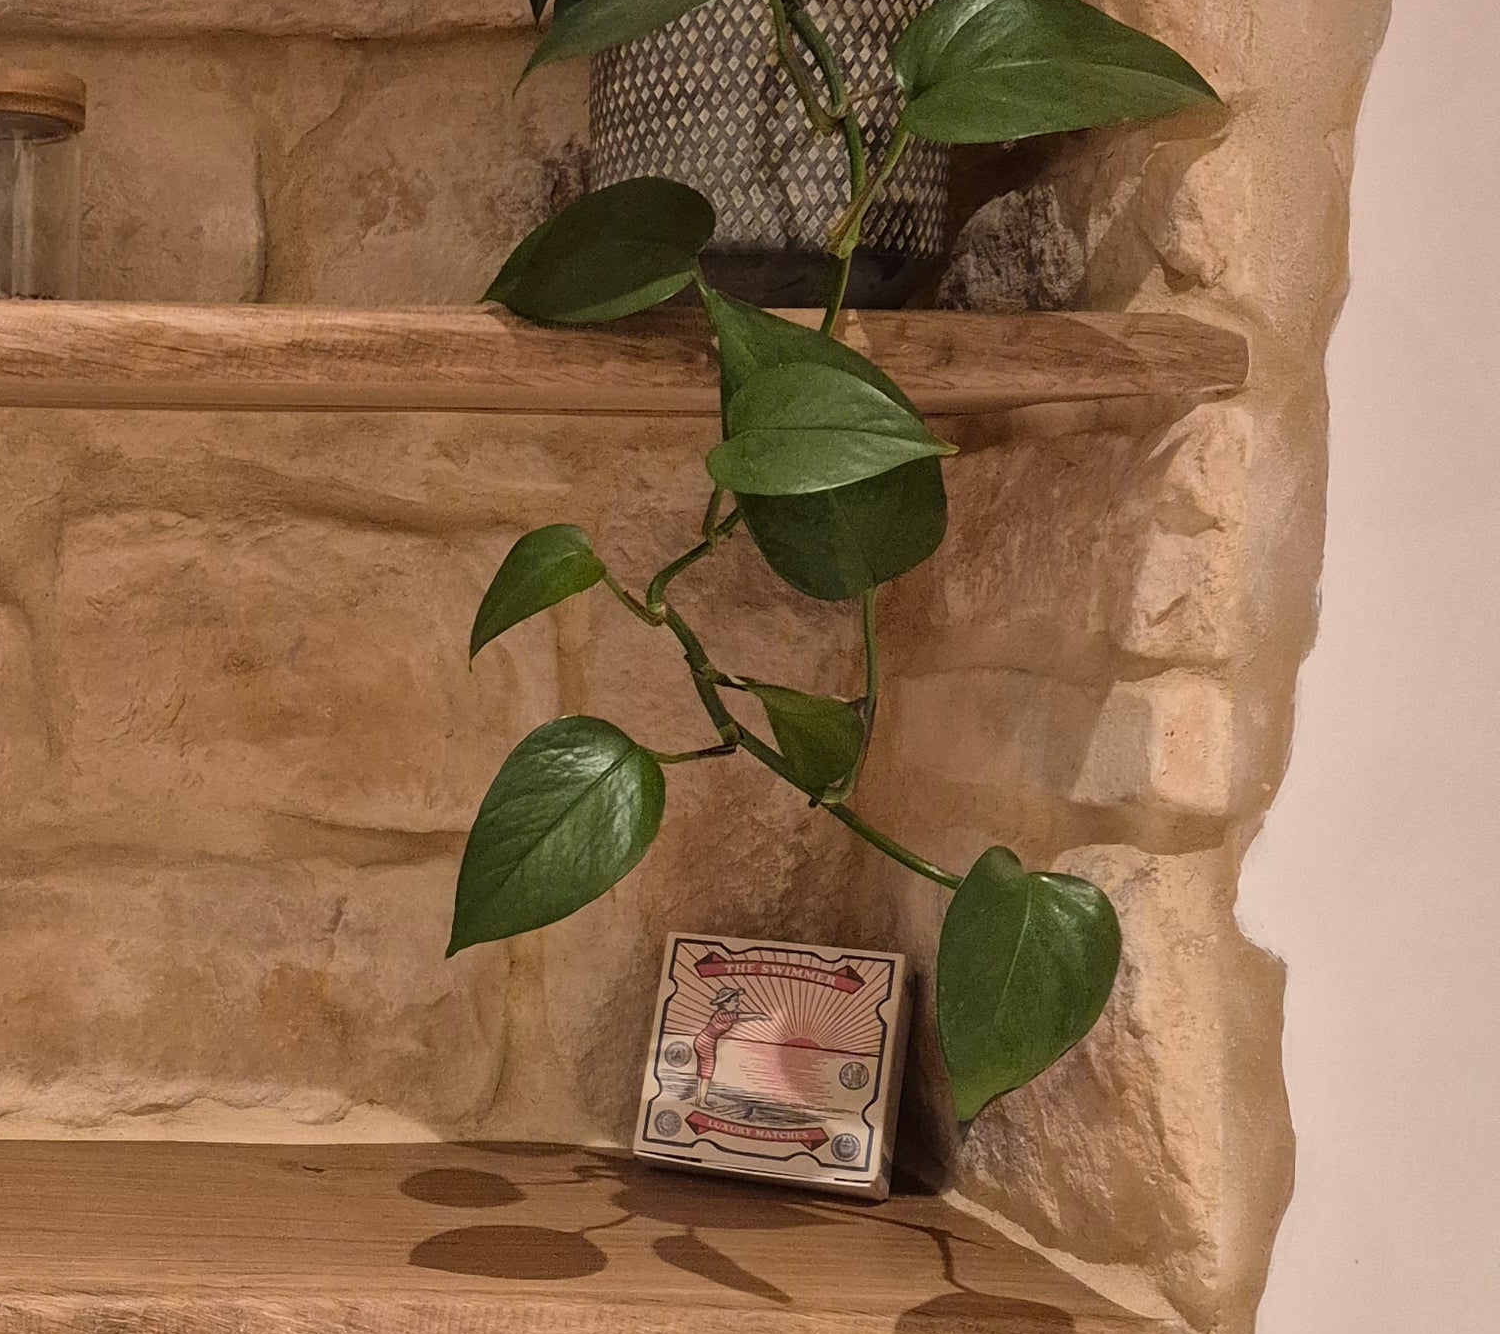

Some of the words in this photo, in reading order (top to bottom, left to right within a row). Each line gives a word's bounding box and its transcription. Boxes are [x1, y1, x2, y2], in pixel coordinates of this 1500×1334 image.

[724, 963, 757, 974] THE
[760, 962, 837, 986] SWIMMER
[708, 1119, 752, 1136] LUXURY
[755, 1129, 809, 1140] MATCHES
